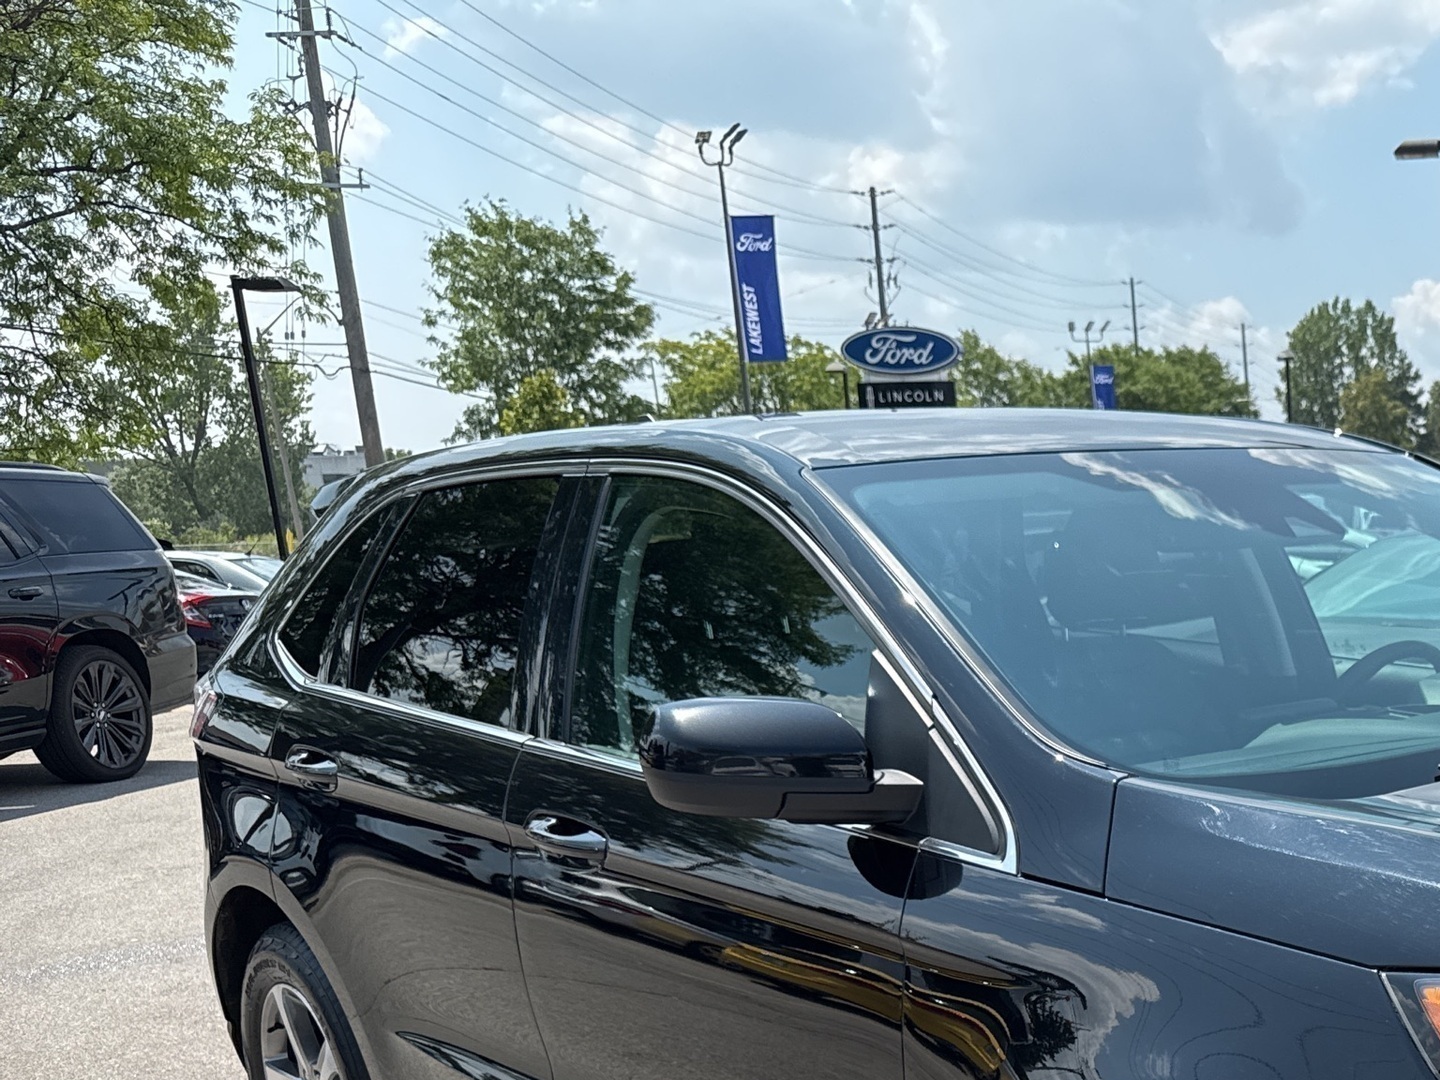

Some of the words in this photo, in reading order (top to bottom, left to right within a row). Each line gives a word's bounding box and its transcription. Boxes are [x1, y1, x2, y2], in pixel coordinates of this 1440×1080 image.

[736, 232, 772, 252] Ford
[741, 282, 764, 356] LAKEWEST
[865, 333, 934, 365] Ford
[878, 390, 944, 403] LINCOLN
